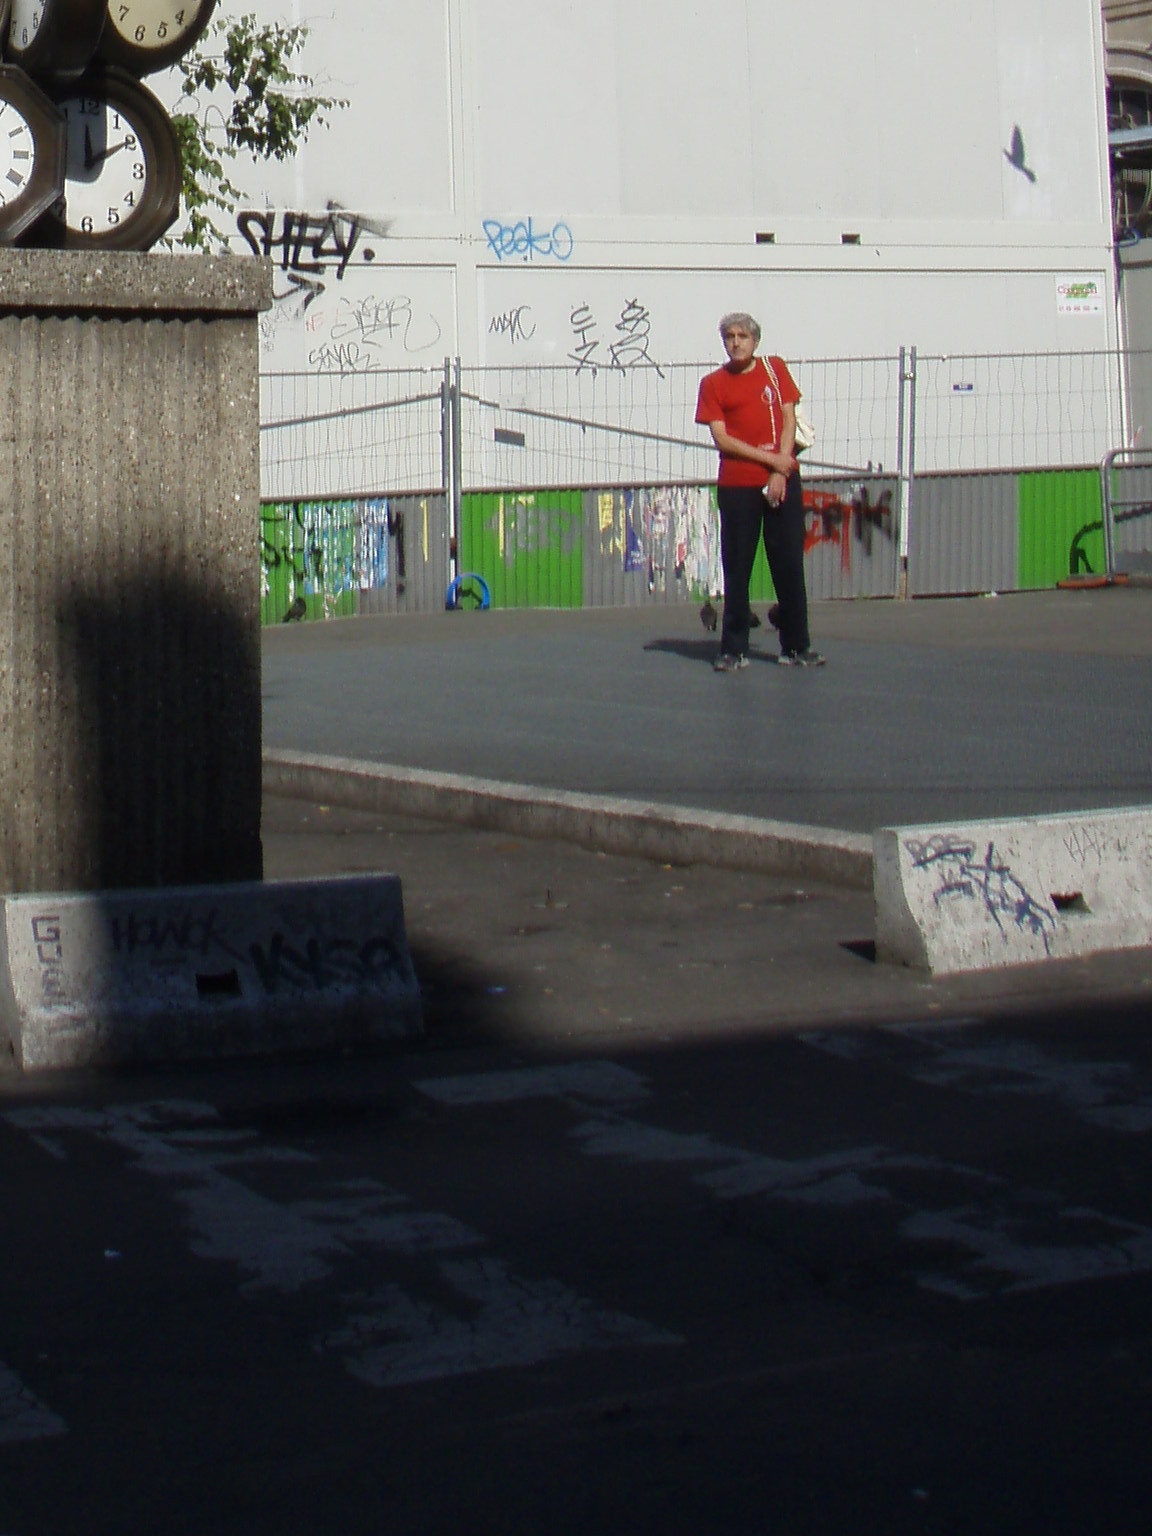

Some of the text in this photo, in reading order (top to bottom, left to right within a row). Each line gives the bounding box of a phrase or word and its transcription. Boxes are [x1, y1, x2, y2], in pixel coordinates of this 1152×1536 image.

[119, 5, 130, 22] 7
[175, 10, 185, 25] 4
[135, 25, 146, 42] 6
[157, 22, 168, 38] 5
[113, 114, 121, 129] 1
[124, 134, 137, 151] 2
[132, 163, 144, 179] 3
[123, 191, 135, 207] 4
[108, 208, 120, 224] 5
[81, 216, 93, 233] 6
